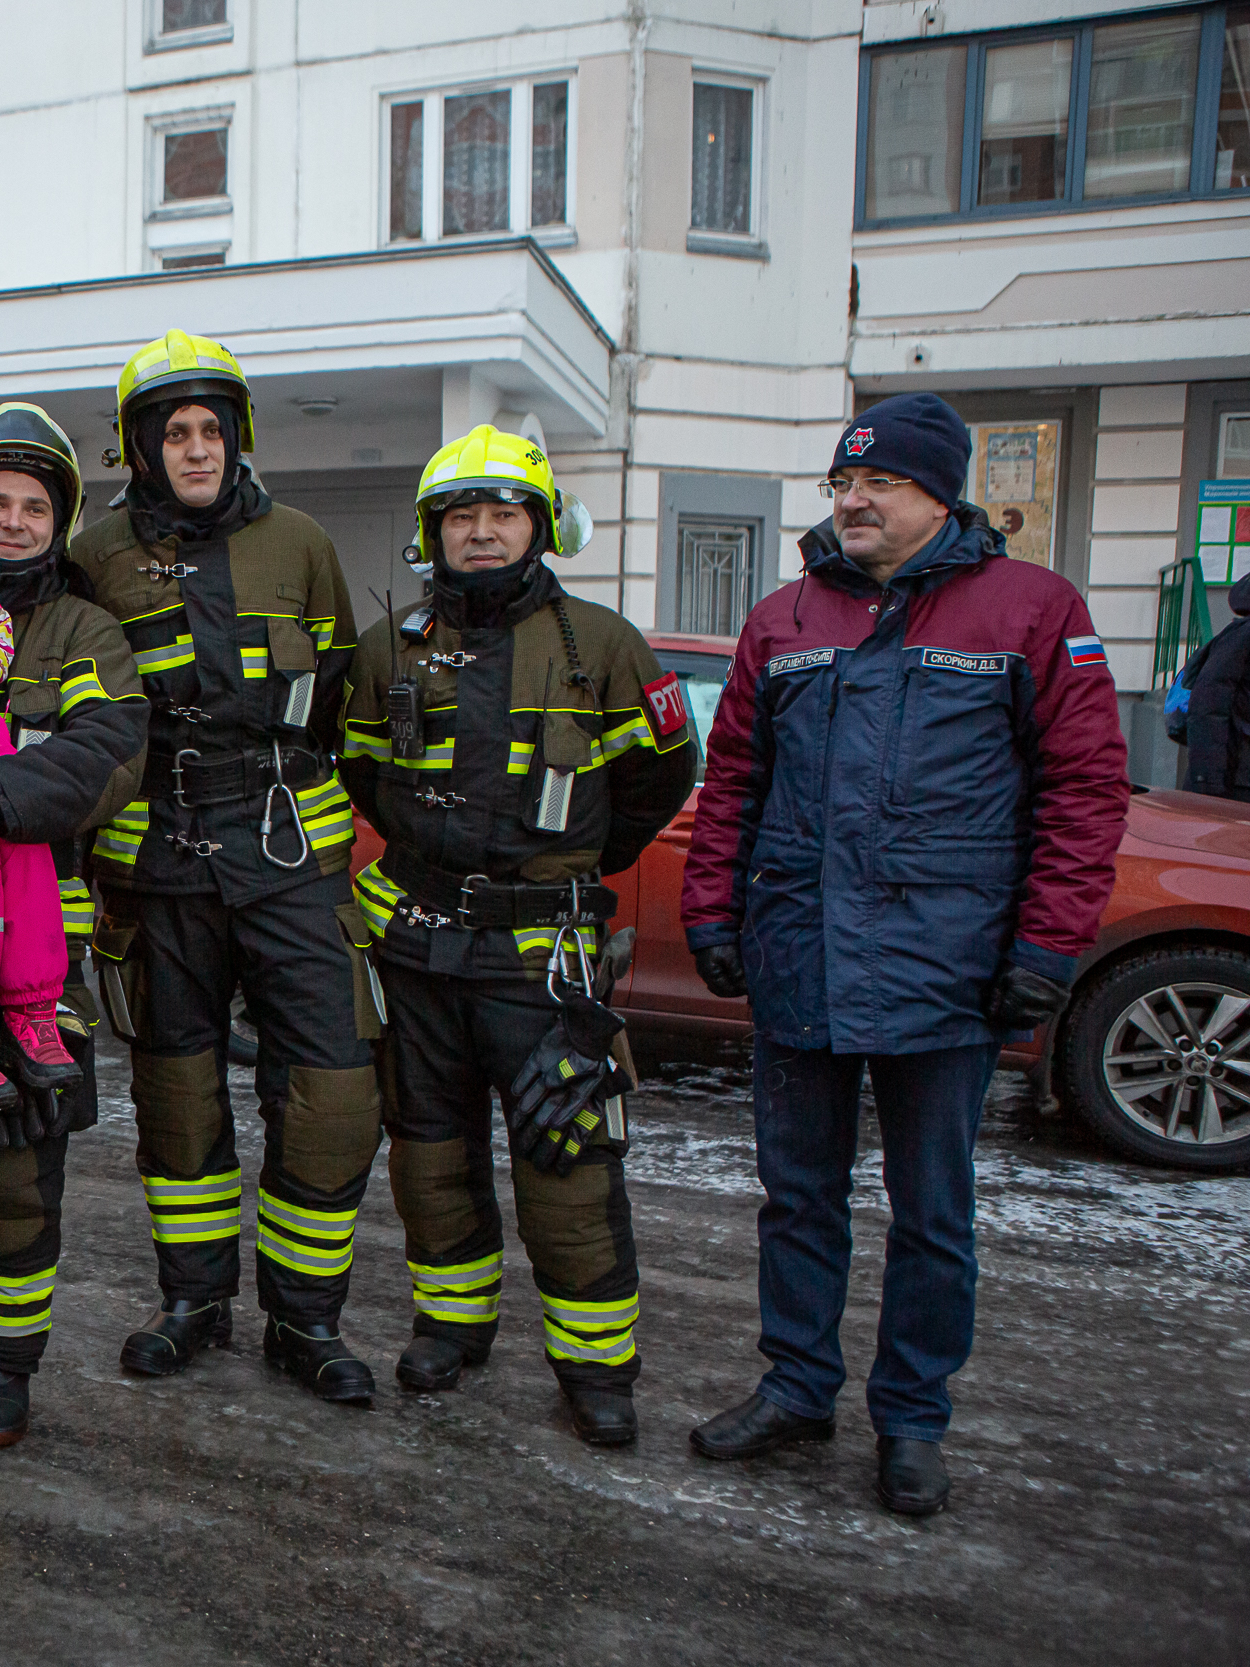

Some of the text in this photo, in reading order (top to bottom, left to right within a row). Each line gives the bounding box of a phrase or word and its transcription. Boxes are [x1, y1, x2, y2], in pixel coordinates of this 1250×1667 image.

[930, 653, 999, 671] СКОРКИН Д.В.
[390, 721, 414, 739] 309
